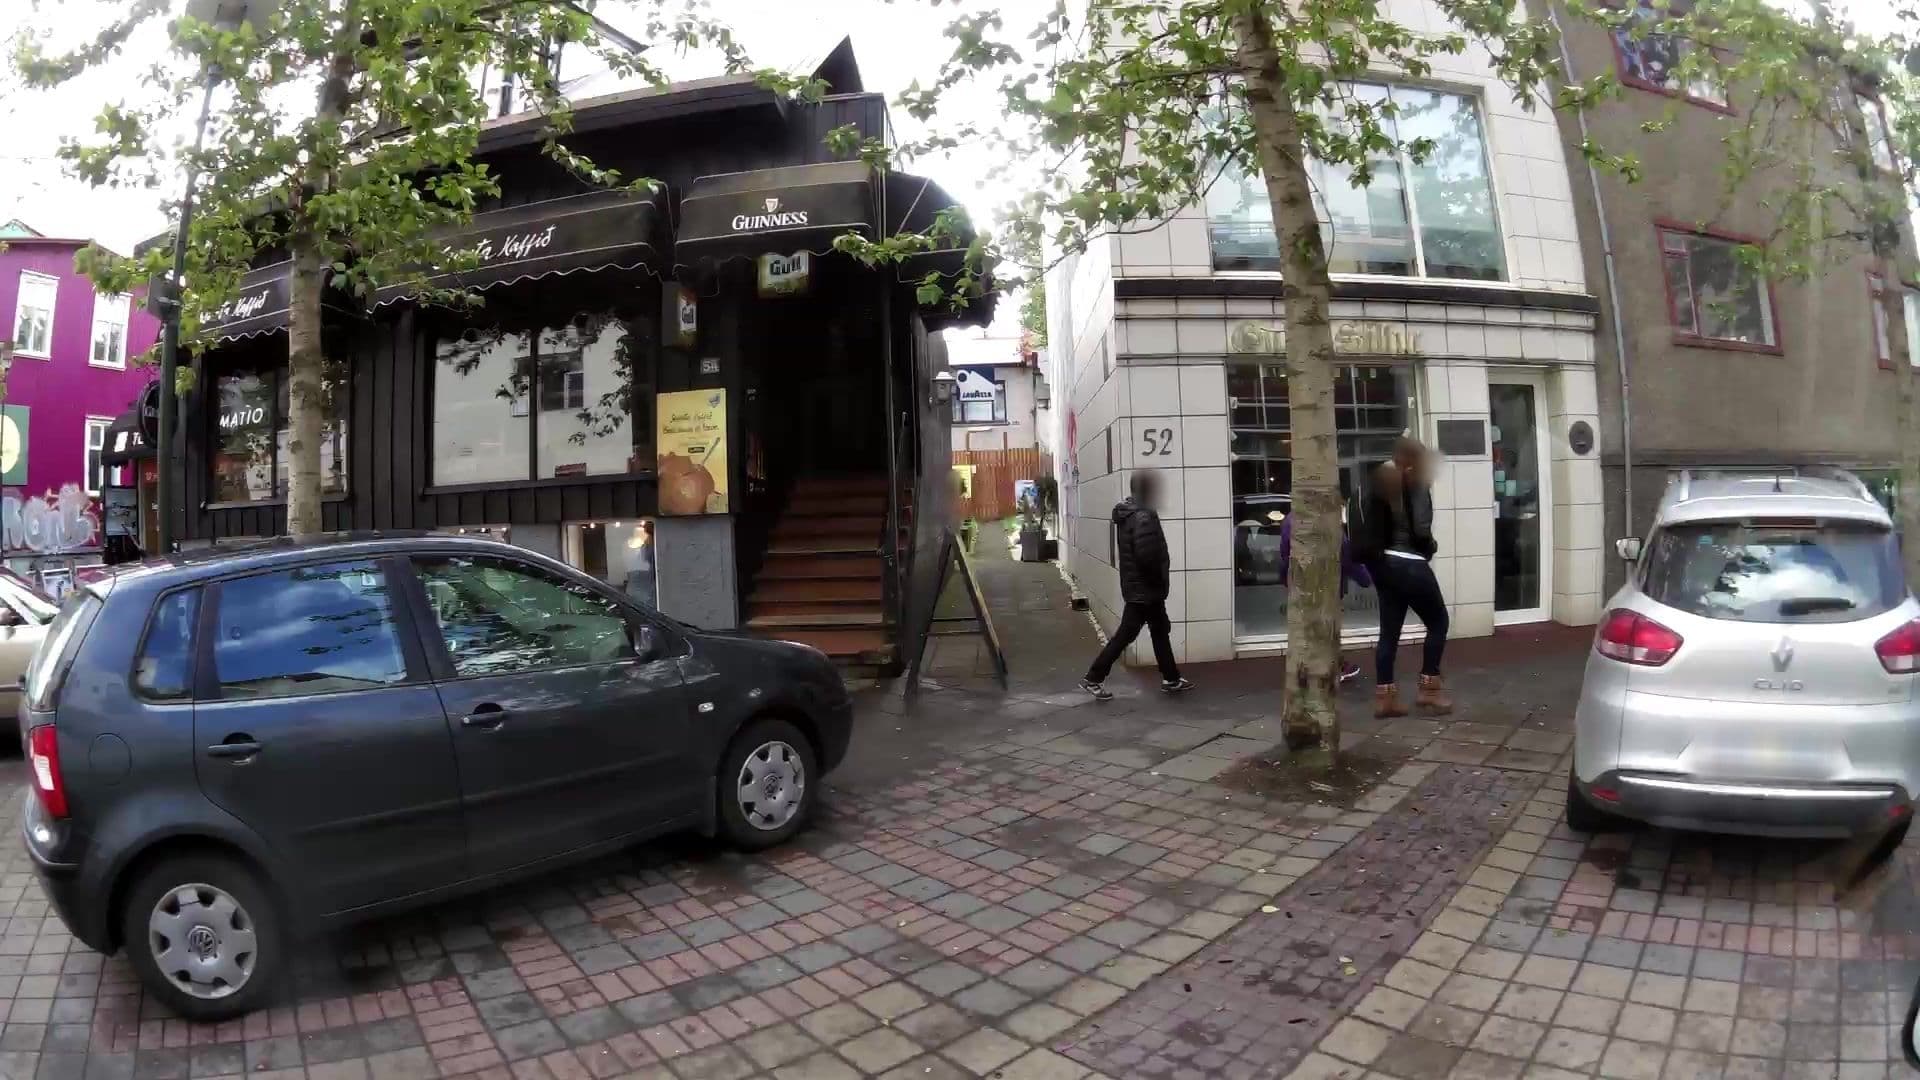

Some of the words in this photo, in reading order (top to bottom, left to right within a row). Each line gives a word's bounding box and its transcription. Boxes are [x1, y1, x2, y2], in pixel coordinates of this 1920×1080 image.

[732, 211, 808, 230] GUINNESS
[1141, 428, 1173, 457] 52
[1753, 678, 1803, 691] CLIO
